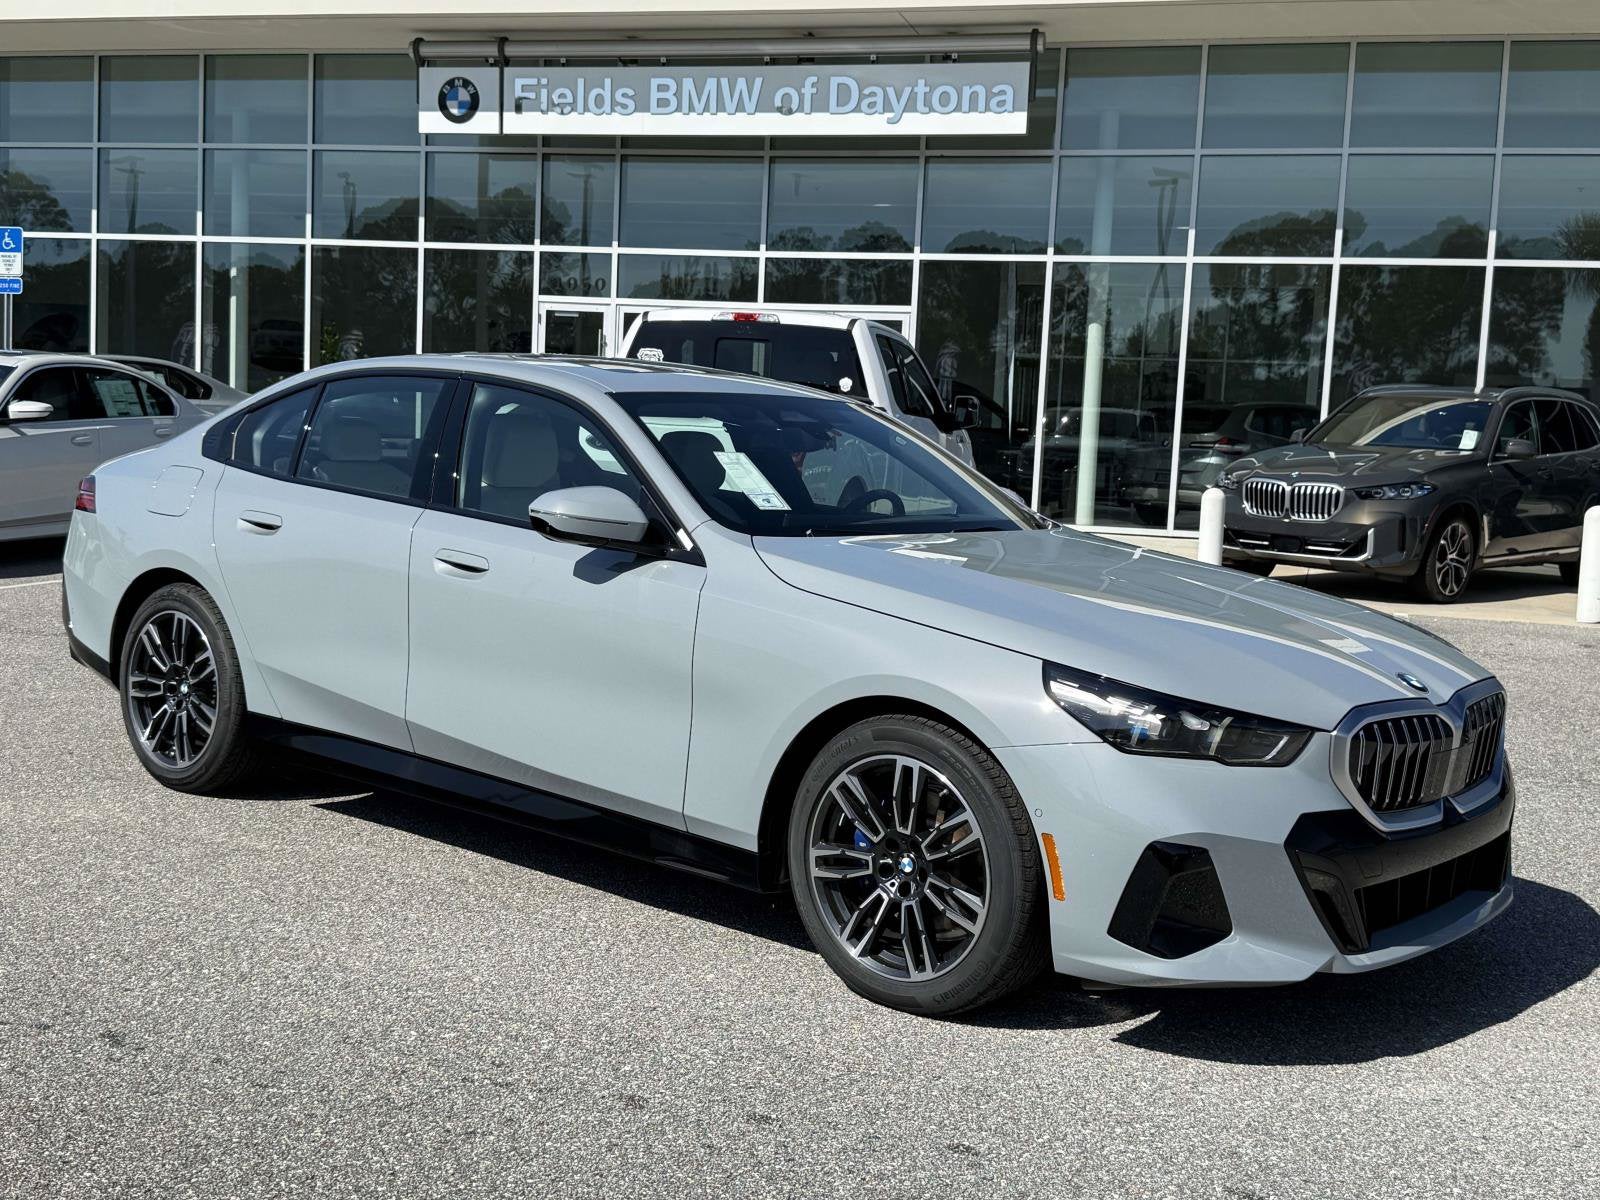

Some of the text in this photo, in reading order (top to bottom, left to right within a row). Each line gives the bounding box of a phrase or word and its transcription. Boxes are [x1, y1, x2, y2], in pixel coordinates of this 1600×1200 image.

[442, 78, 478, 95] BMW
[514, 75, 1015, 124] Fields BMW of Daytona
